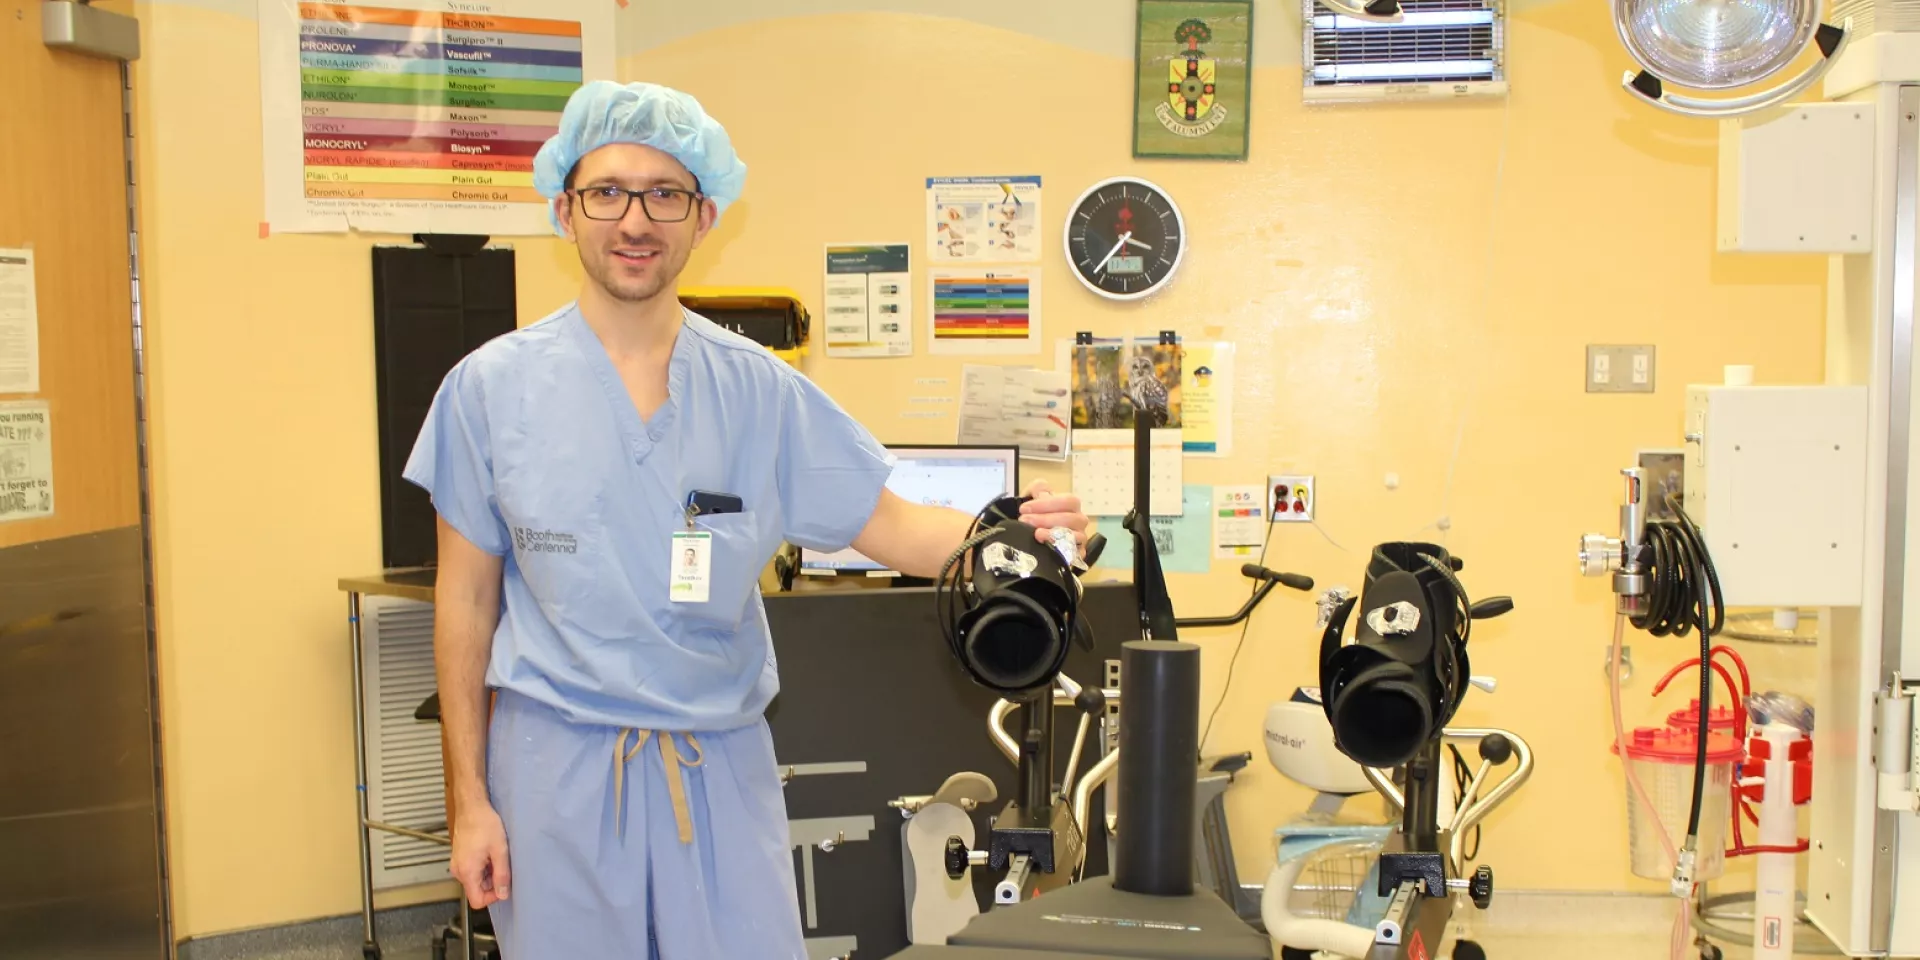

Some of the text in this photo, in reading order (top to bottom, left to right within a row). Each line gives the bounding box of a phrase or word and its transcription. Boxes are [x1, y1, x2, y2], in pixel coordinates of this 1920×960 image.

[452, 175, 493, 185] Plain Gut
[452, 190, 508, 201] Chromic Gut
[526, 527, 555, 541] Booth
[526, 539, 577, 554] Centennial
